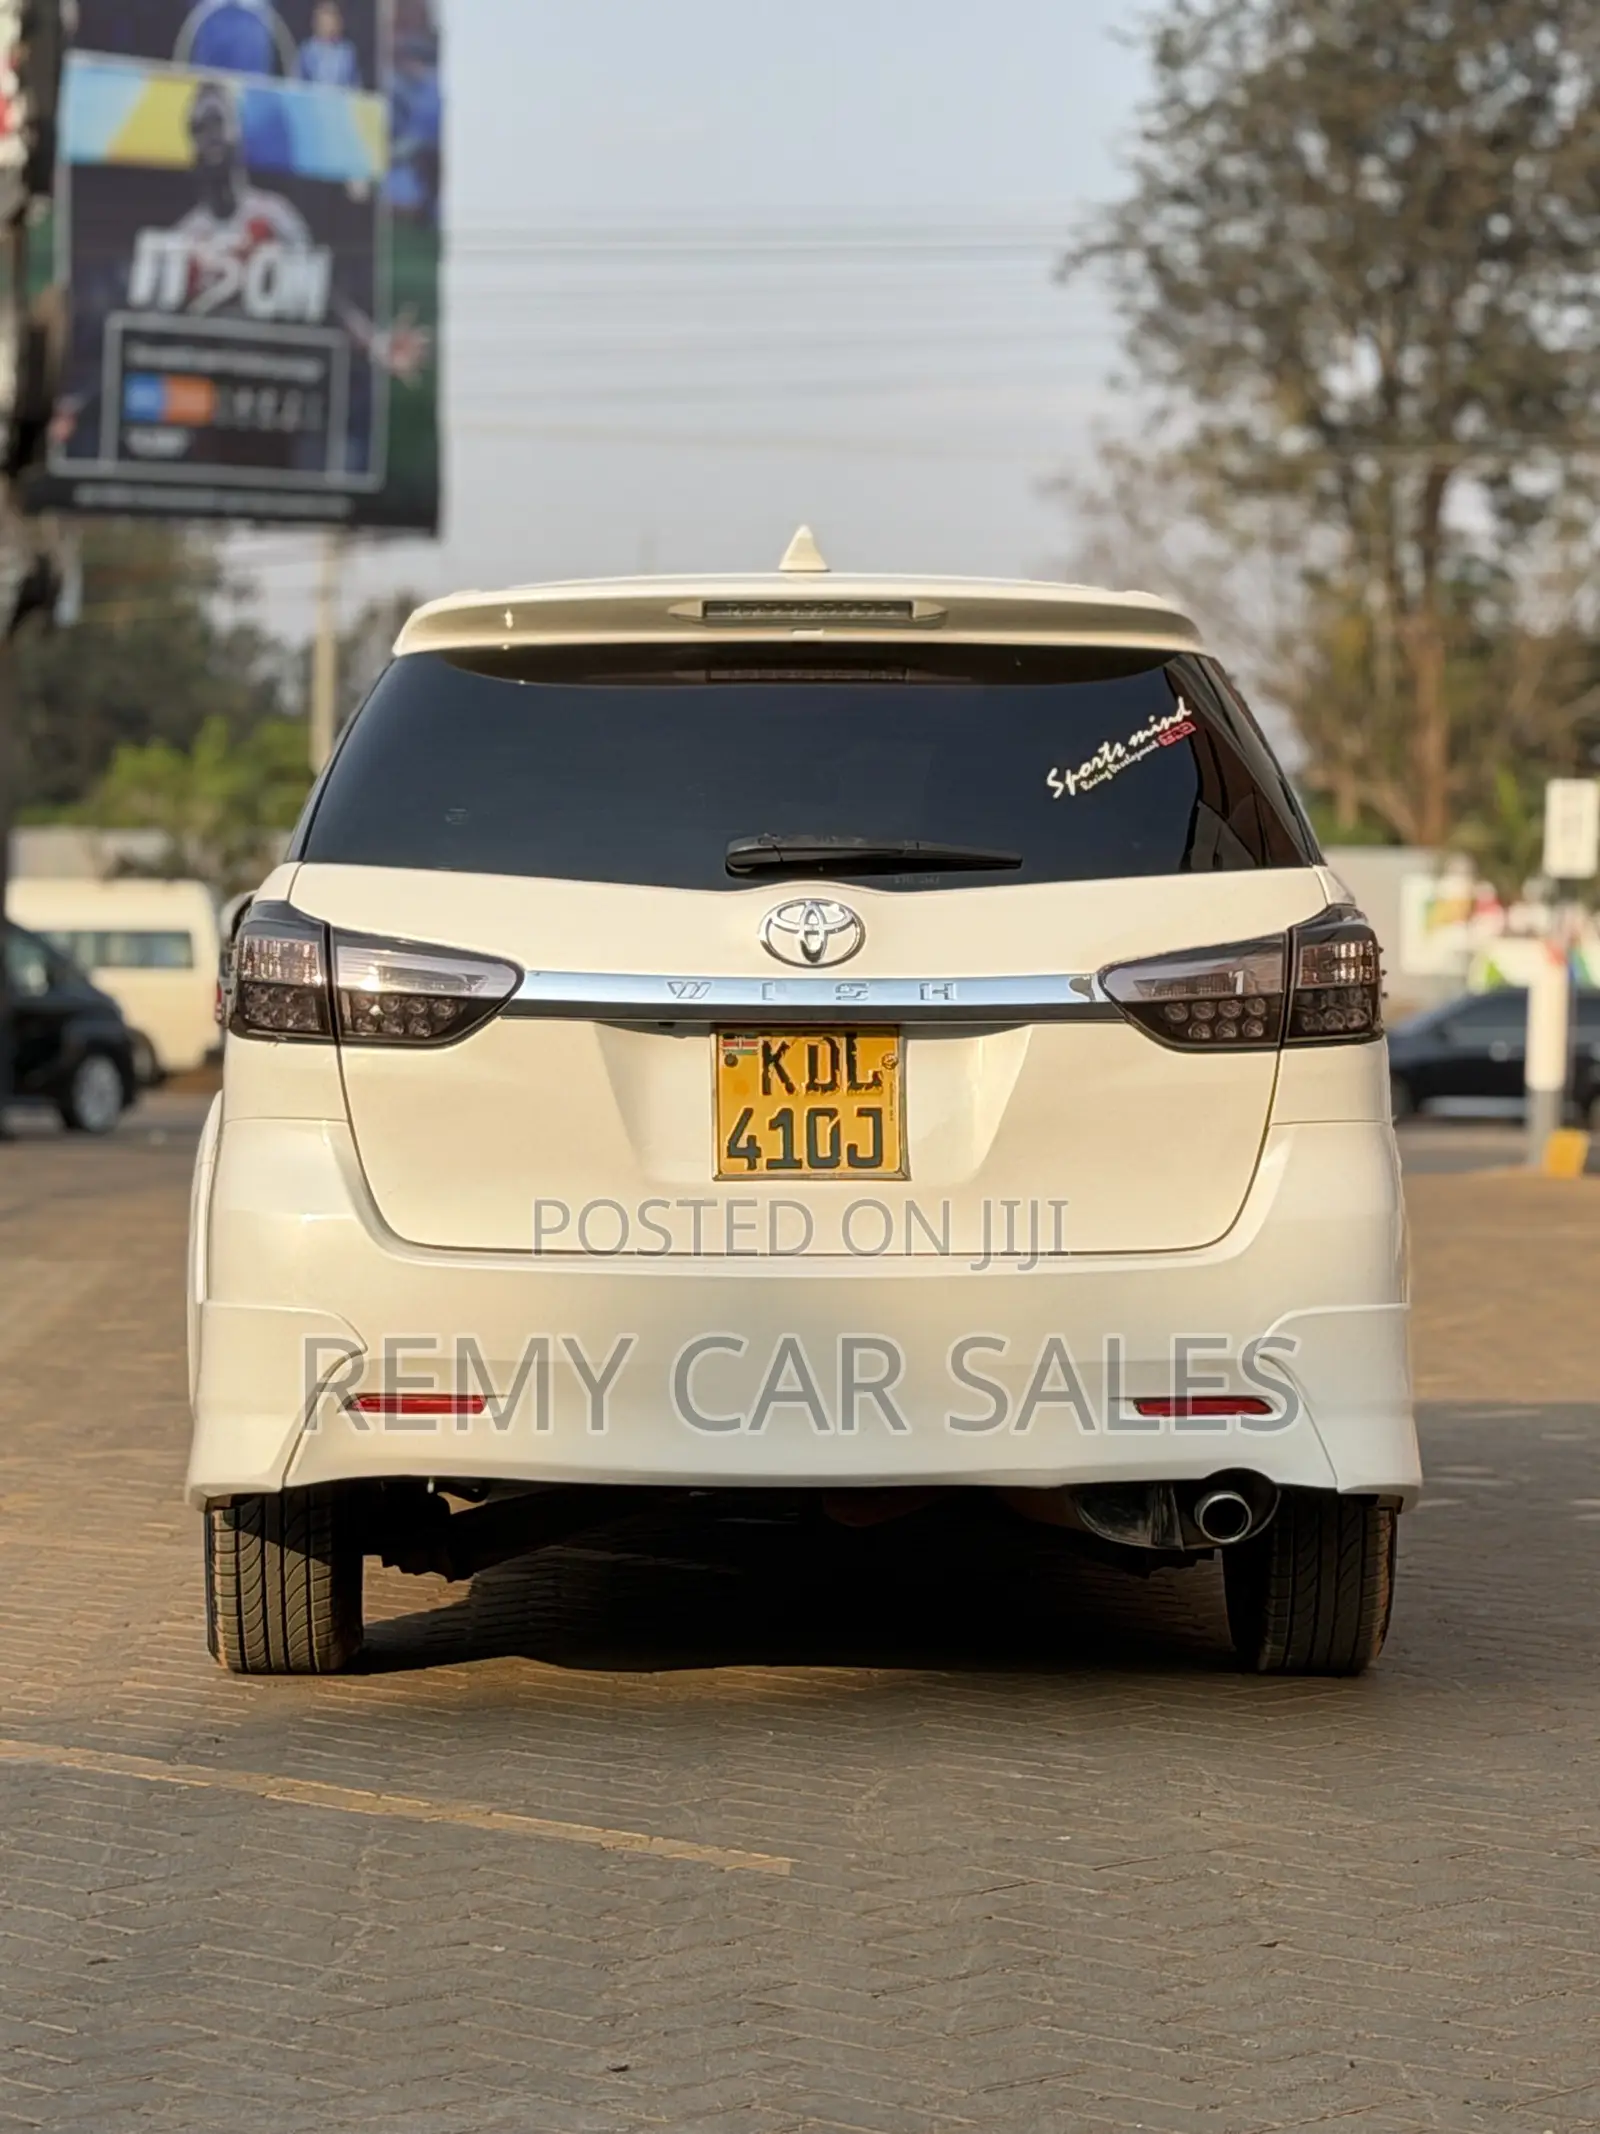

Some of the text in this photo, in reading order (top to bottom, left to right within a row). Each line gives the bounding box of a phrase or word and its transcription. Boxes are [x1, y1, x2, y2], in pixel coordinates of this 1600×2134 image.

[1046, 741, 1126, 799] Sports
[1128, 696, 1192, 747] mind
[667, 981, 957, 1001] WISH
[761, 1032, 883, 1096] KDL
[726, 1107, 884, 1170] 410J
